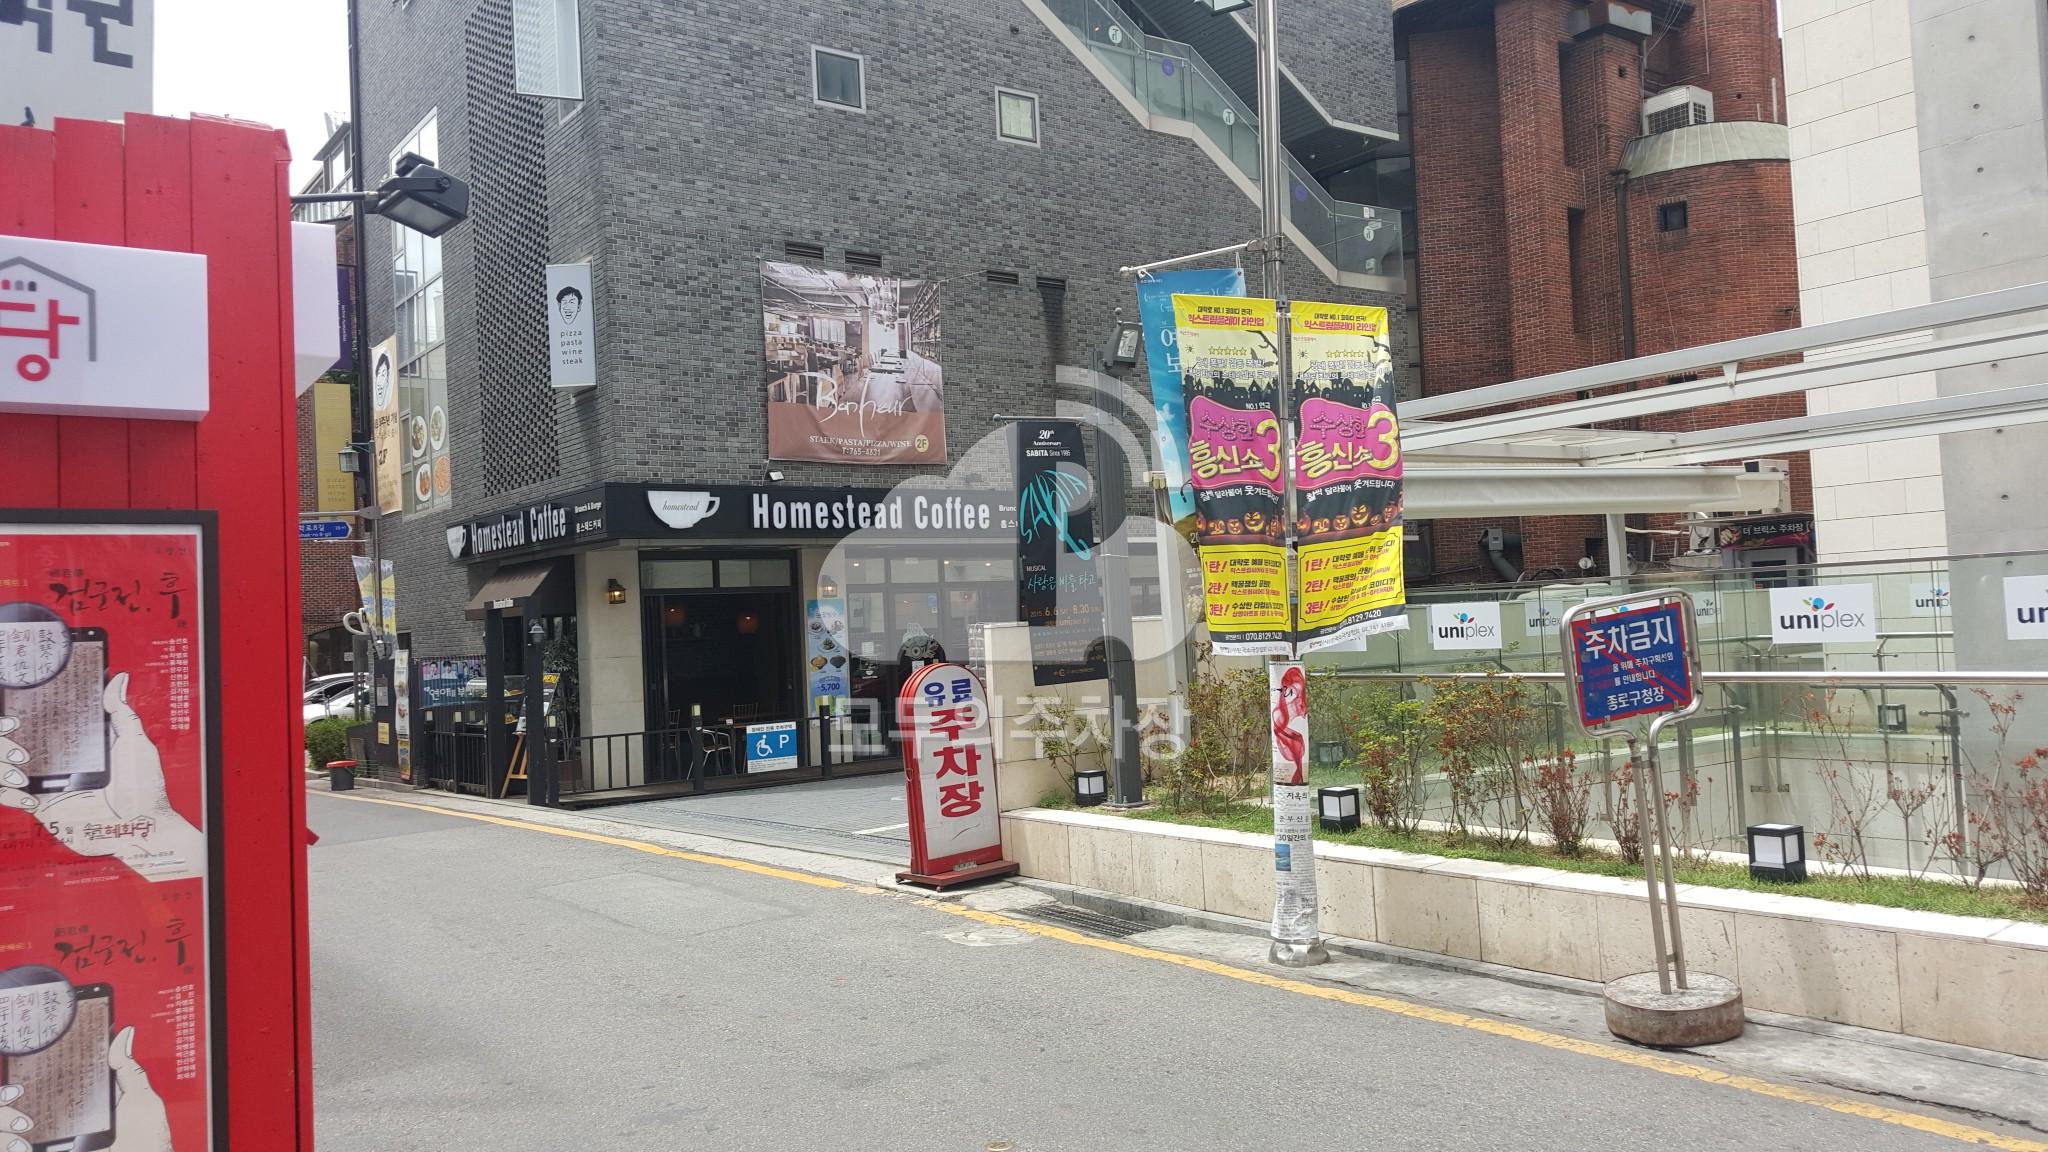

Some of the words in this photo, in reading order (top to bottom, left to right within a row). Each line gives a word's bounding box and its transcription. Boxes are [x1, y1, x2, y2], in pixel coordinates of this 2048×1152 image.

[560, 330, 583, 339] pizza
[561, 340, 583, 348] pasta
[561, 348, 583, 356] wine
[562, 357, 583, 365] steak
[1200, 412, 1254, 441] 수상한
[1309, 411, 1368, 440] 수상한
[916, 438, 928, 449] 2F
[1297, 440, 1374, 480] 흥신소
[1366, 410, 1400, 471] 3
[1190, 440, 1265, 480] 흥신소
[662, 496, 700, 511] homestead
[752, 493, 903, 529] Homestead
[914, 495, 990, 530] Coffee
[471, 511, 525, 555] Homestead
[529, 503, 566, 543] Coffee
[1742, 527, 1751, 536] 더
[1779, 523, 1804, 533] 주차장
[1208, 582, 1229, 595] 2탄!
[1304, 578, 1330, 594] 2탄!
[1209, 602, 1230, 616] 3탄!
[1304, 600, 1330, 615] 3탄!
[1528, 614, 1561, 628] uniplex
[1779, 609, 1865, 633] uniplex
[1438, 623, 1495, 641] uniplex
[1585, 616, 1675, 660] 주차금지
[1620, 659, 1634, 671] 위해
[1622, 669, 1656, 685] 안내합니다
[924, 678, 972, 708] 유료
[1606, 686, 1665, 711] 종로구청장
[779, 734, 790, 749] P
[930, 706, 985, 819] 주차장
[105, 820, 152, 840] 혜화당
